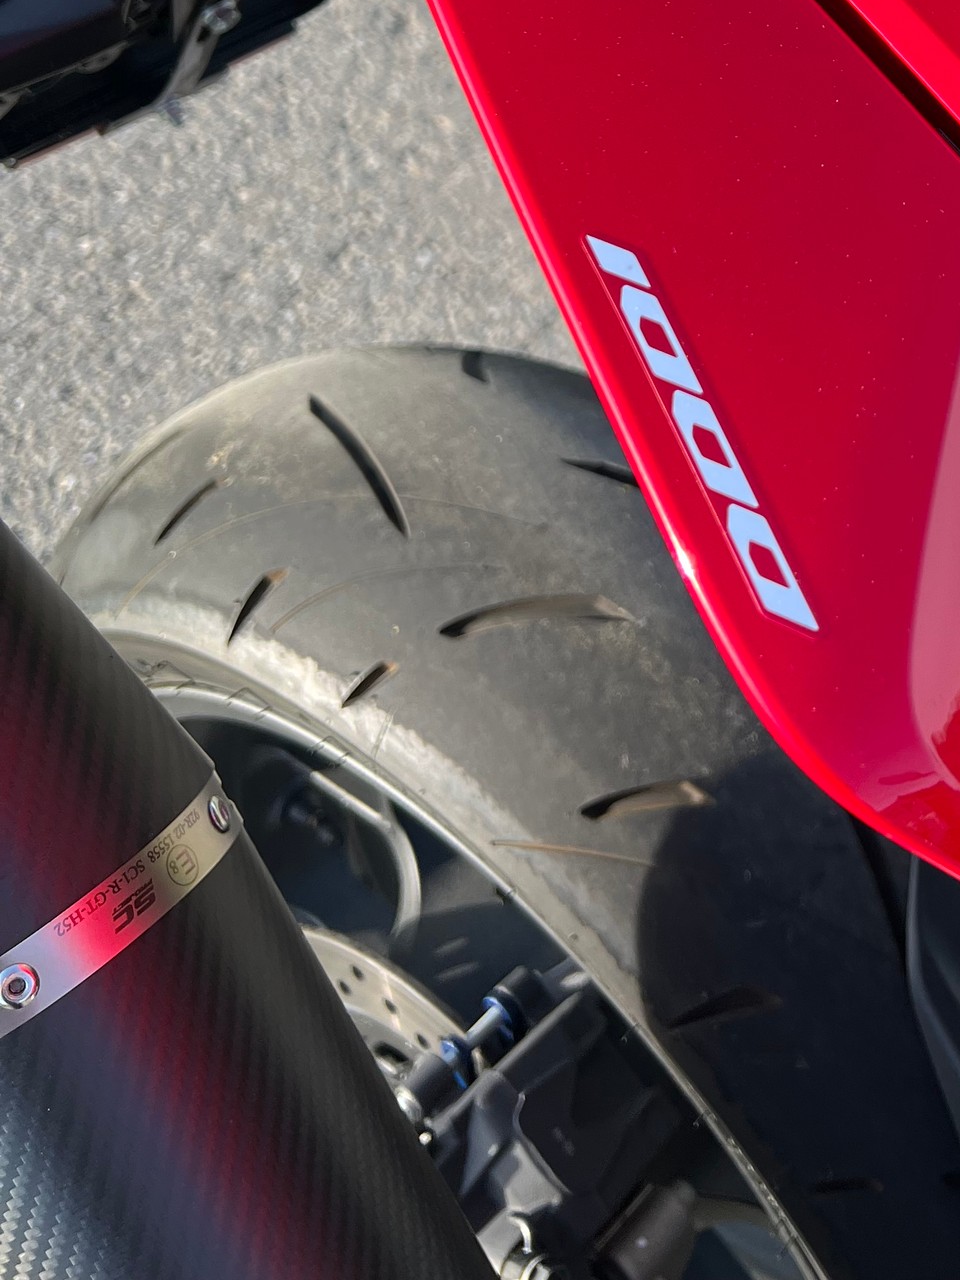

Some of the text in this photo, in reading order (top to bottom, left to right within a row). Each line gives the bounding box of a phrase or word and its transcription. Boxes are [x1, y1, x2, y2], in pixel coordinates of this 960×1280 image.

[586, 234, 820, 632] 1000
[147, 836, 175, 863] 15558
[112, 886, 156, 934] SC
